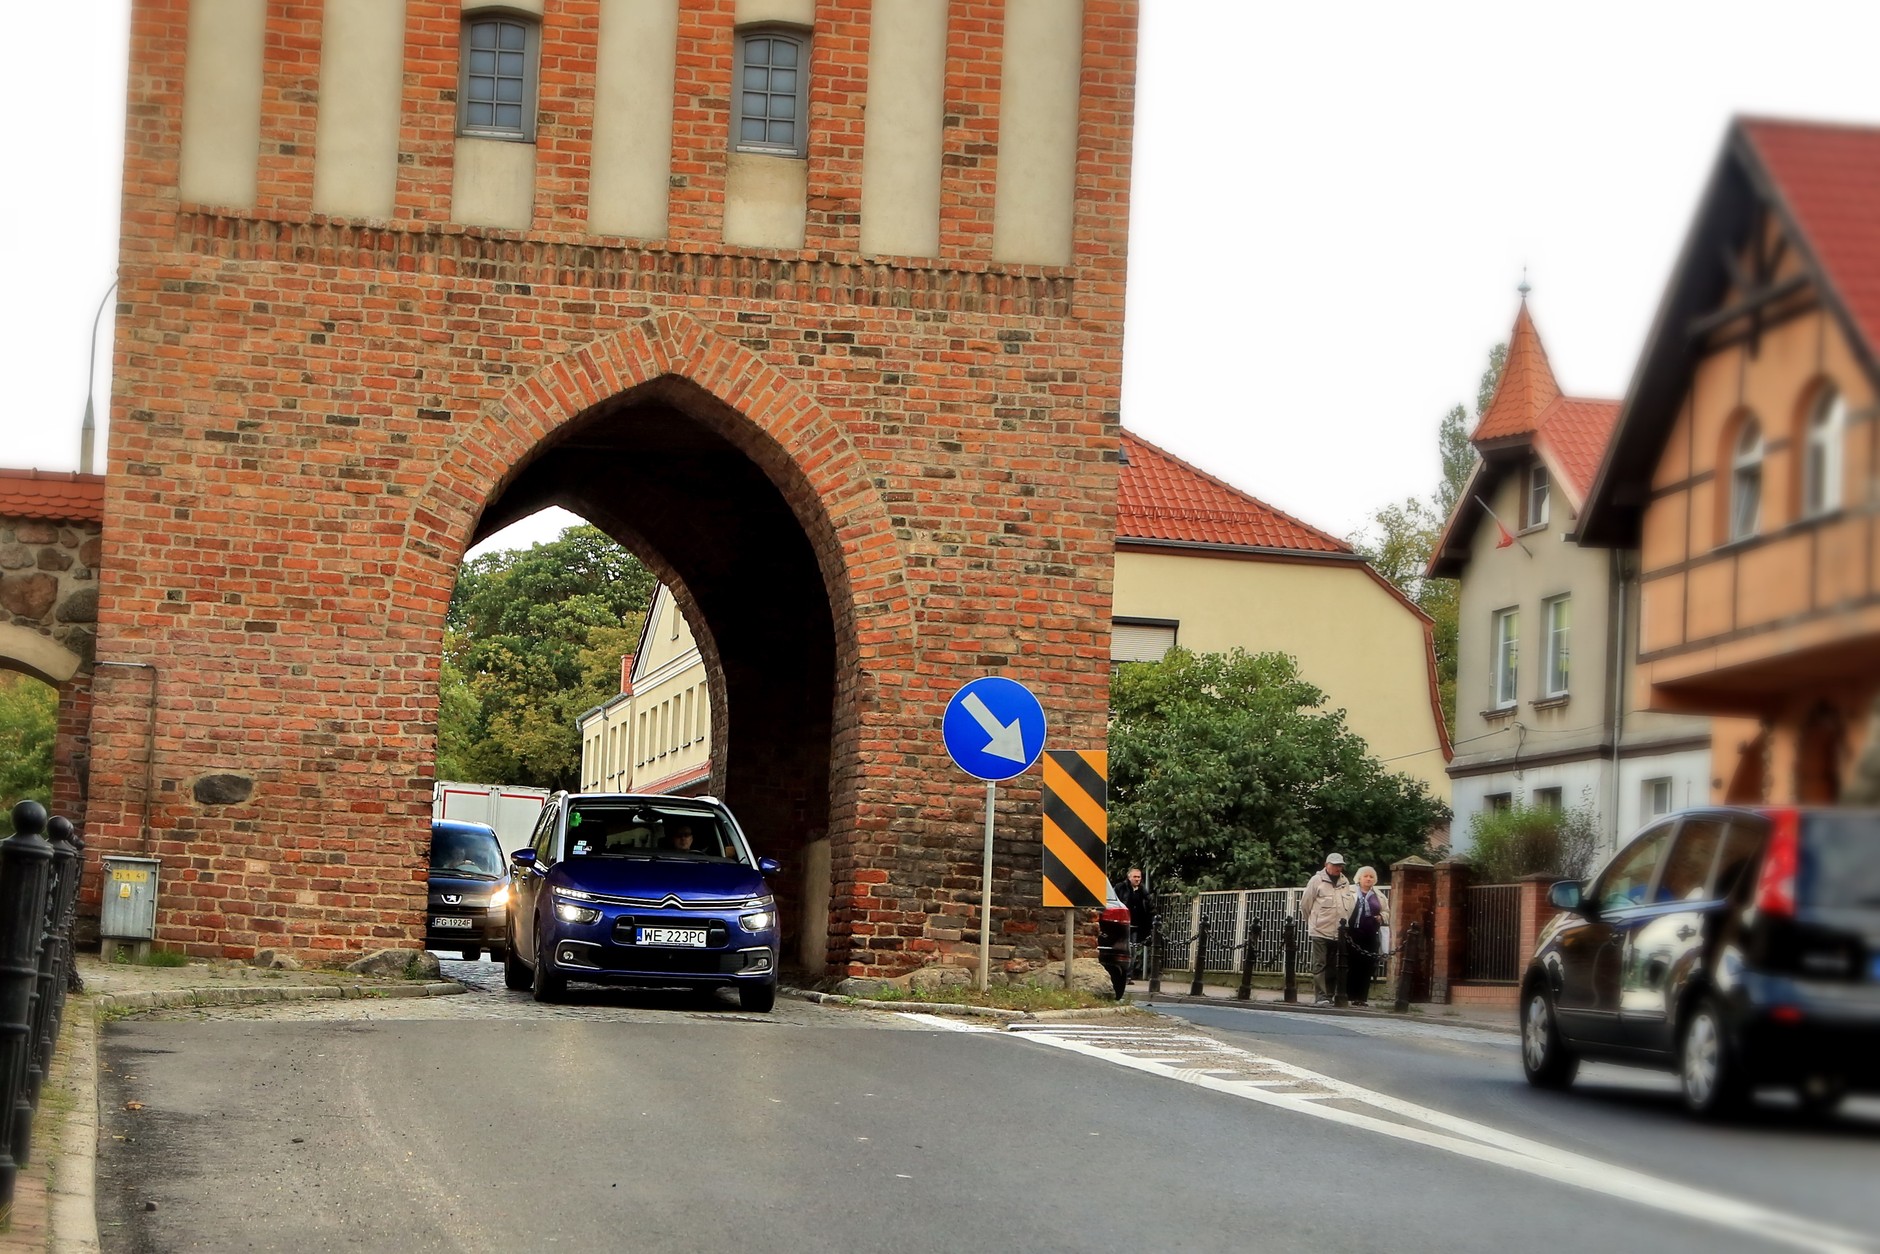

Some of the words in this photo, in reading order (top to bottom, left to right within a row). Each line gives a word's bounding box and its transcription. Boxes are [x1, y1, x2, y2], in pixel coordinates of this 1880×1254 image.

[436, 918, 447, 926] FG
[644, 929, 662, 941] WE
[666, 930, 705, 943] 223PC
